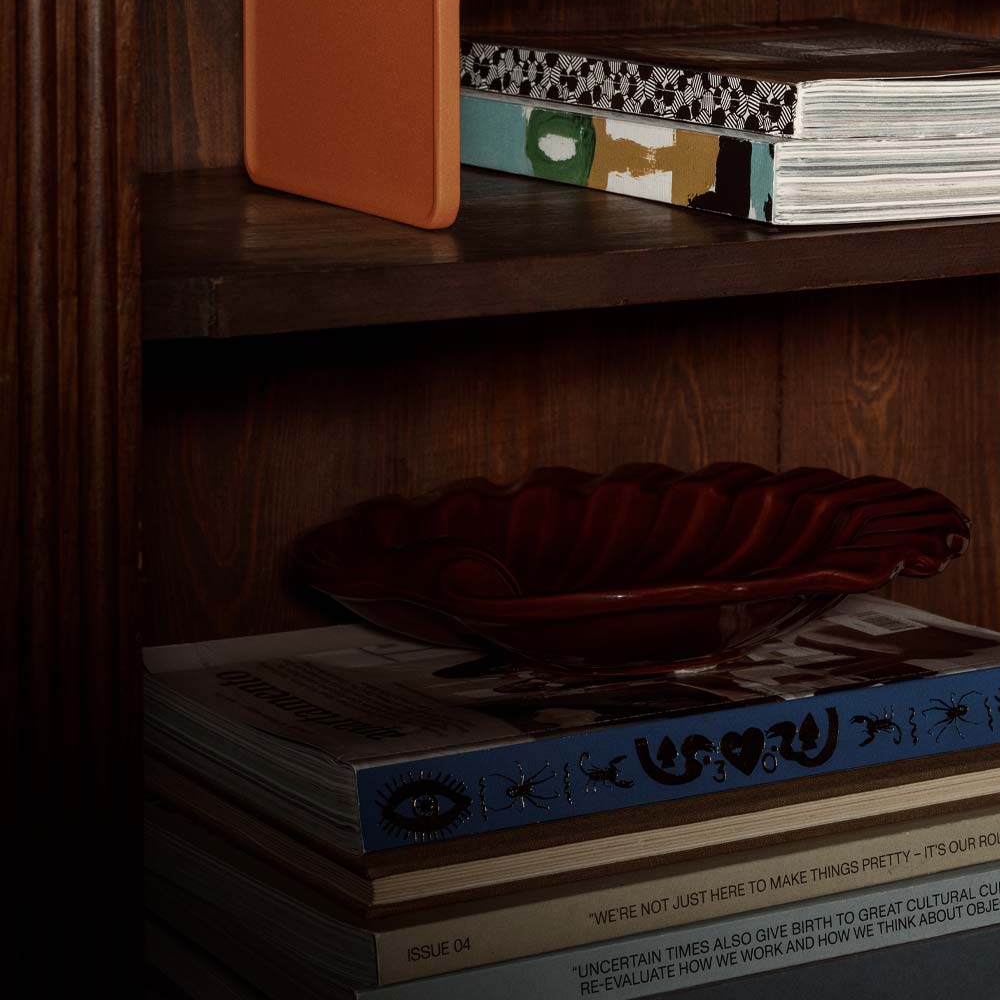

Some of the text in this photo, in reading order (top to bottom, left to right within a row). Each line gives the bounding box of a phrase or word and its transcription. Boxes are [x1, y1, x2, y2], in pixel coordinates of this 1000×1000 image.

[588, 904, 638, 926] "WE'RE
[641, 898, 670, 917] NOT
[673, 890, 707, 910] JUST
[710, 883, 746, 902] HERE
[748, 878, 767, 894] TO
[770, 870, 808, 890] MAKE
[810, 860, 859, 881] THINGS
[862, 850, 911, 871] PRETTY
[924, 842, 947, 860] IT'S
[948, 836, 976, 854] OUR
[407, 937, 471, 962] ISSUE 04
[572, 949, 662, 978] "UNCERTAIN
[666, 940, 710, 961] TIMES
[713, 932, 752, 951] ALSO
[755, 924, 788, 943] GIVE
[792, 916, 833, 936] BIRTH
[836, 911, 855, 927] TO
[858, 901, 903, 922] GREAT
[906, 888, 977, 912] CULTURAL
[580, 964, 676, 996] RE-EVALUATE
[679, 956, 713, 976] HOW
[716, 951, 738, 968] WE
[741, 941, 784, 963] WORK
[786, 936, 815, 954] AND
[818, 928, 850, 948] HOW
[853, 924, 874, 940] WE
[877, 914, 916, 935] THINK
[919, 905, 963, 927] ABOUT
